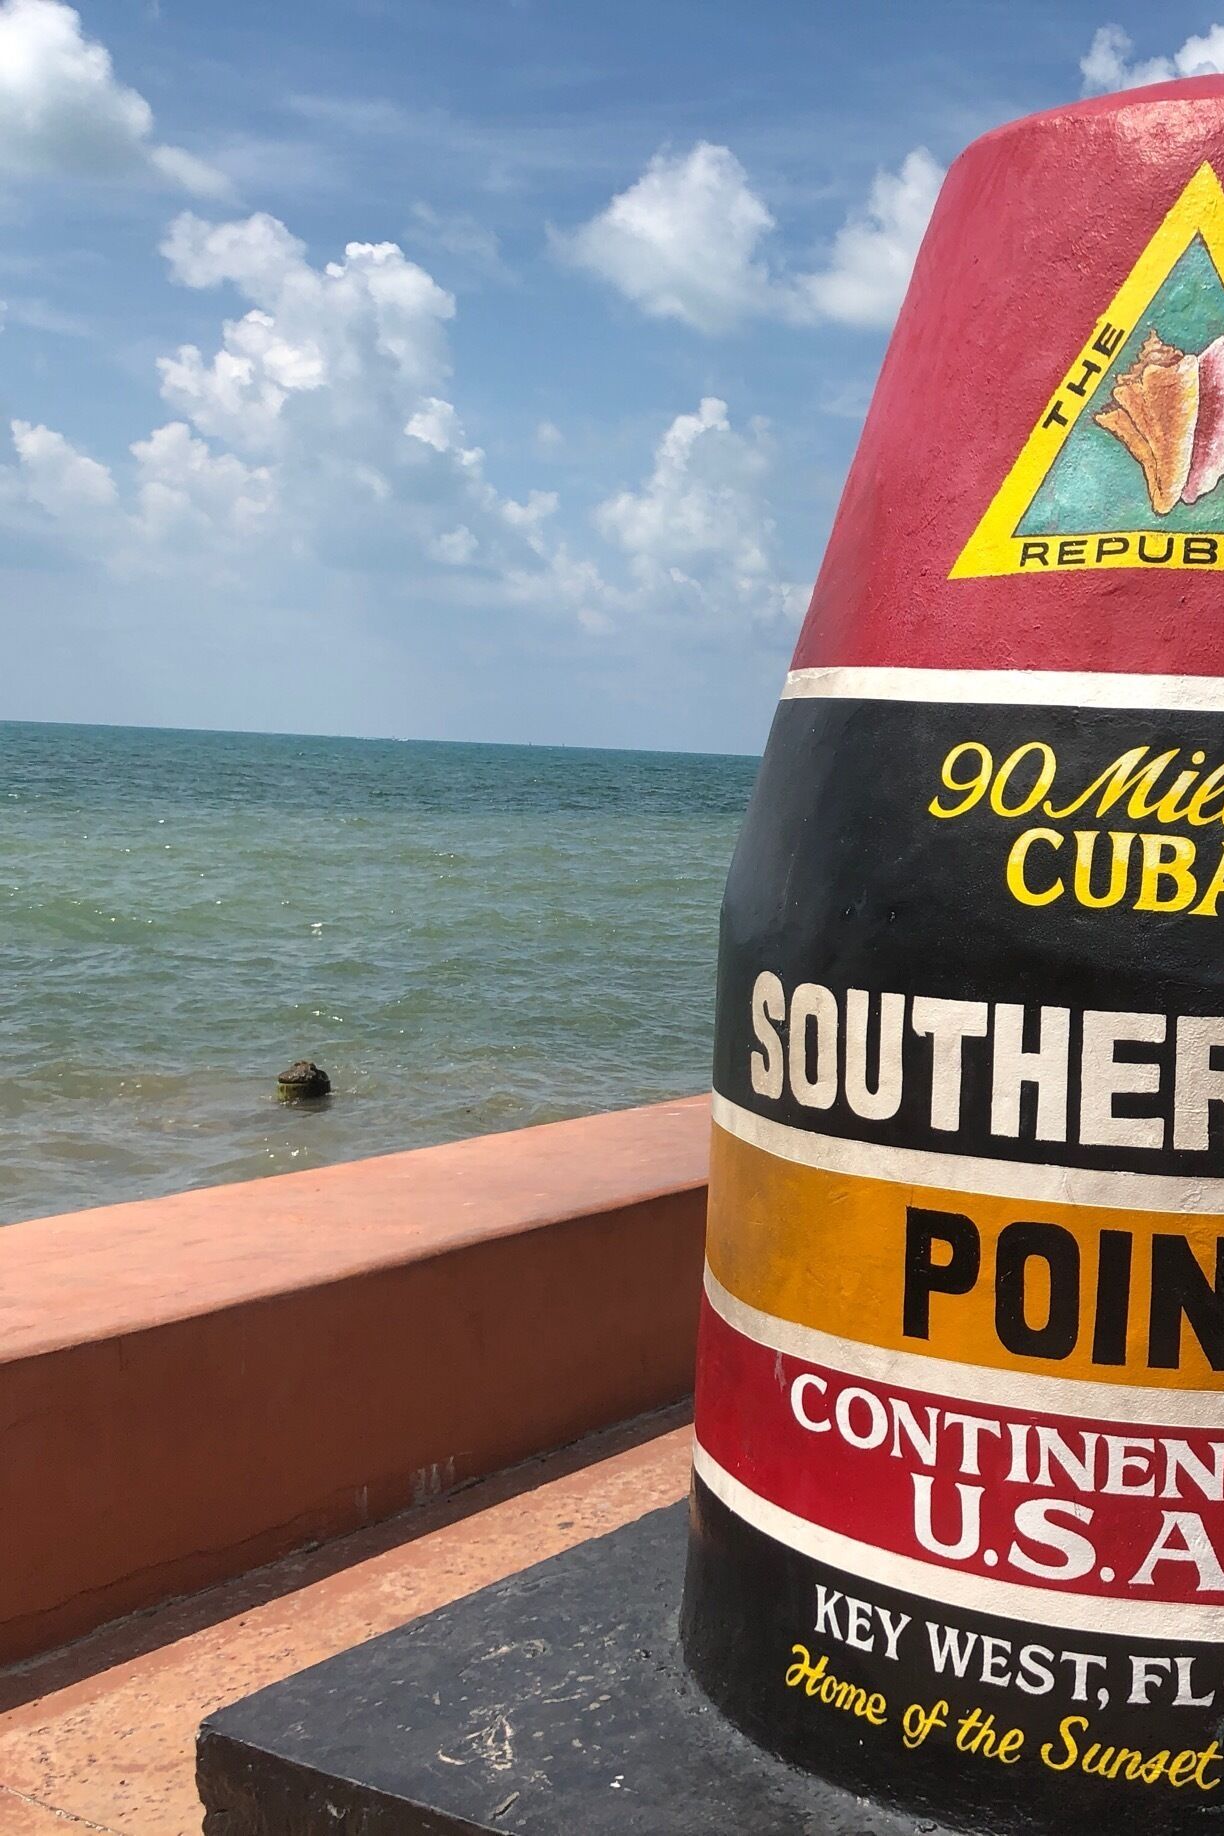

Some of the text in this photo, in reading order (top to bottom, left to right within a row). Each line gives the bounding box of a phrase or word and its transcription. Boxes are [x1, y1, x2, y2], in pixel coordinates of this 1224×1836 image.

[1041, 321, 1125, 432] THE
[928, 741, 1057, 819] 90
[785, 1643, 888, 1726] Home
[902, 1698, 951, 1749] of
[955, 1708, 1024, 1764] the
[813, 1584, 1216, 1710] KEY WEST, FL
